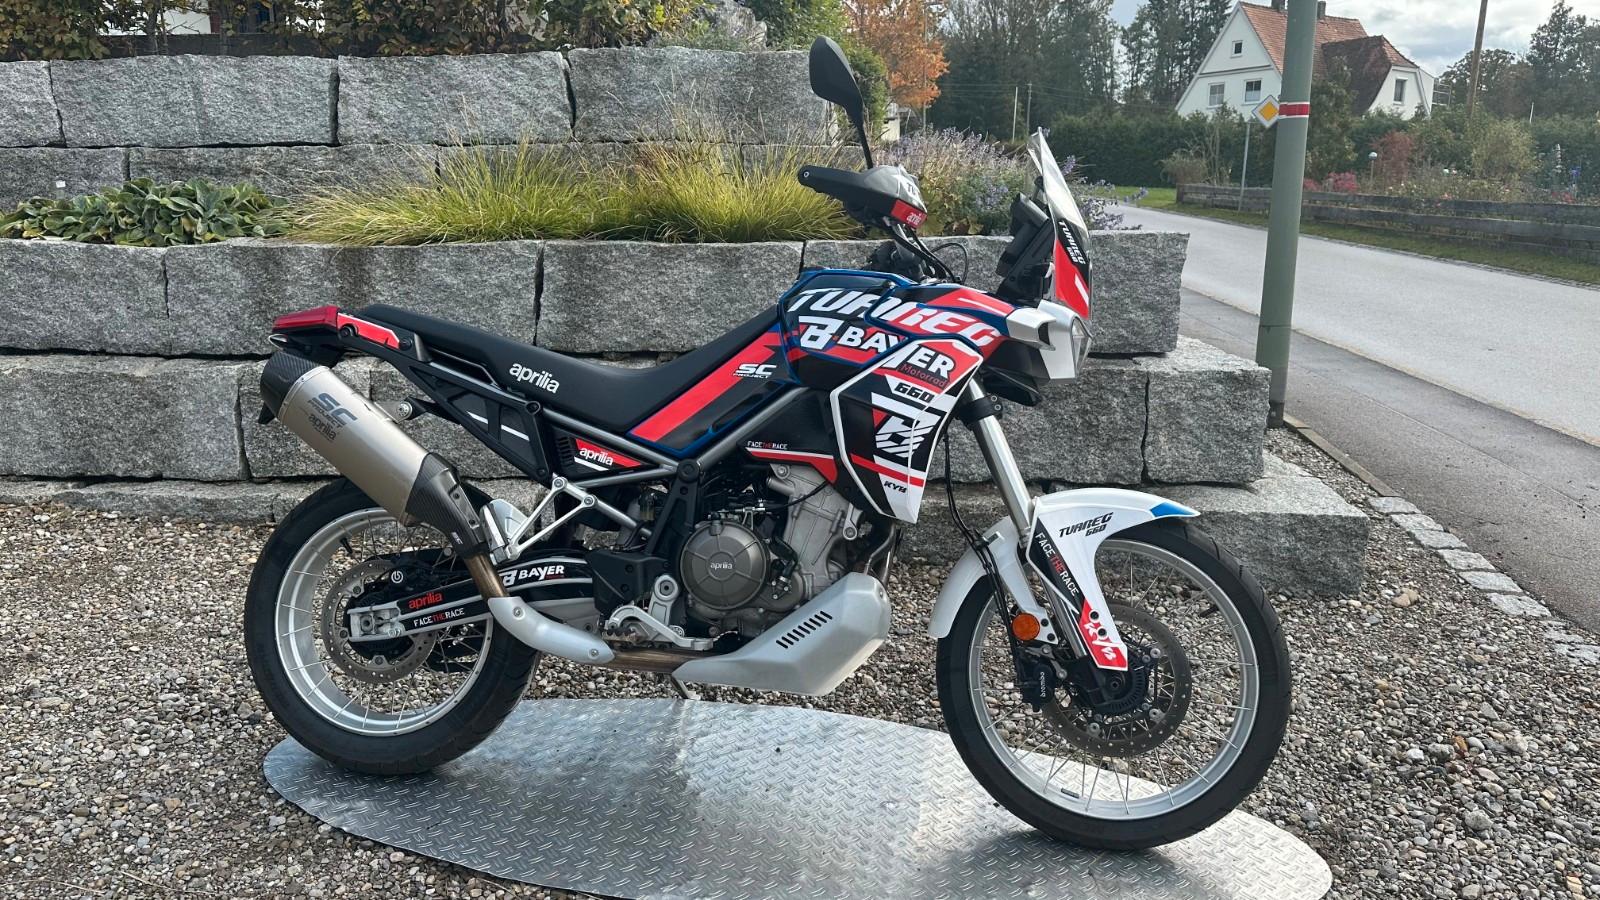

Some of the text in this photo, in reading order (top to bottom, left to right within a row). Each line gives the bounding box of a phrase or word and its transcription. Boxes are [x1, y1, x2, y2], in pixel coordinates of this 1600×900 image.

[509, 362, 560, 394] aprilia
[735, 363, 777, 376] SC
[901, 363, 948, 387] Motorrad
[894, 382, 936, 403] 660
[311, 392, 358, 426] SC
[308, 413, 337, 441] aprilia
[579, 447, 614, 466] aprilia
[883, 480, 908, 494] KYB
[1059, 511, 1114, 538] TUAREG
[1085, 523, 1107, 537] 660
[518, 565, 565, 581] BAYER
[710, 561, 734, 571] aprilia
[408, 591, 443, 610] aprilia
